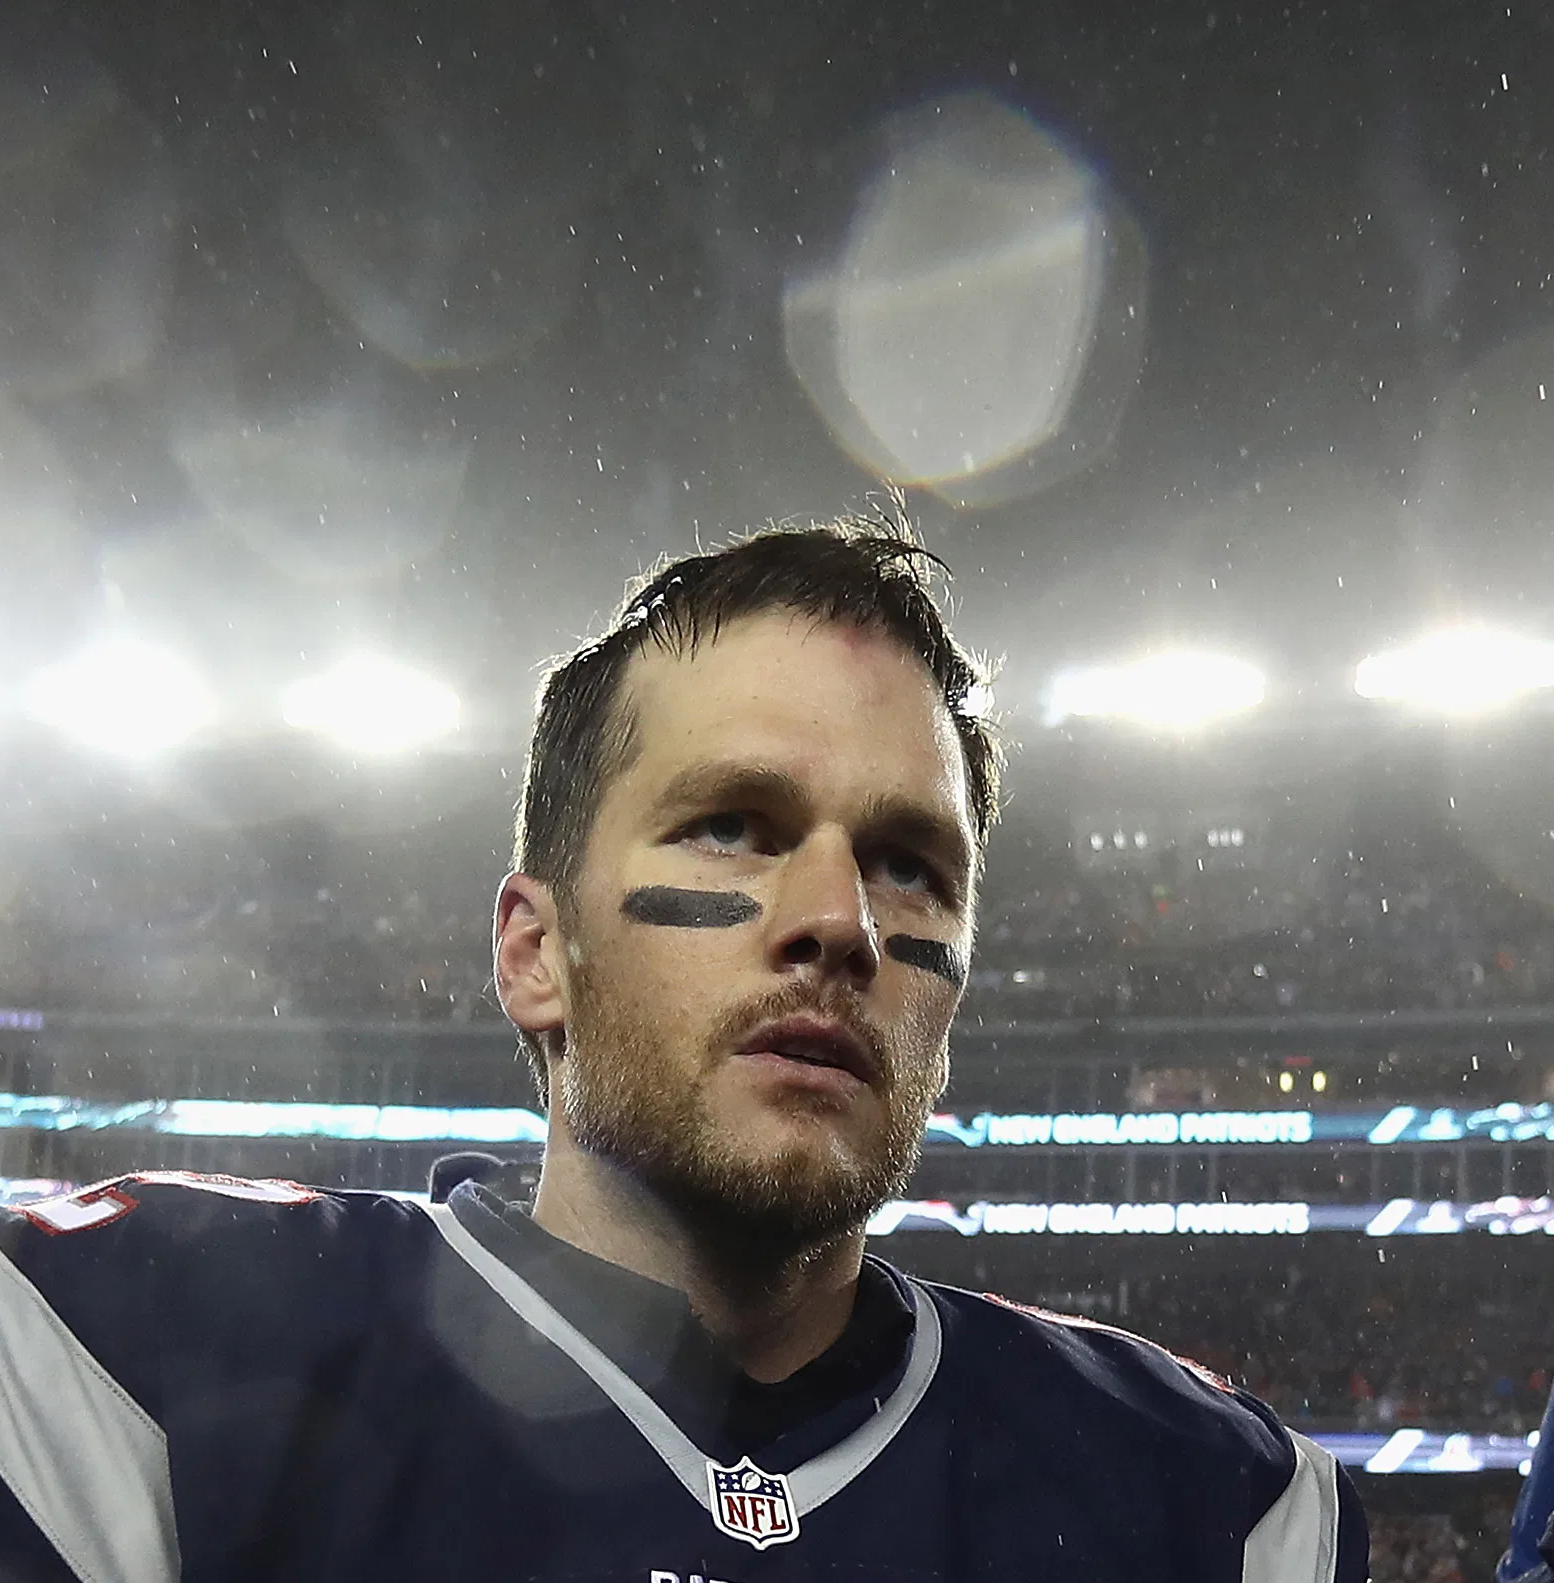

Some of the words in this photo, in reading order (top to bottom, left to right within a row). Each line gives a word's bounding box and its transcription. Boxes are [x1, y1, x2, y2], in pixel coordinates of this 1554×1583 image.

[988, 1114, 1051, 1144] NEW
[1052, 1113, 1179, 1144] ENGLAND
[1180, 1111, 1311, 1143] PATRIOTS
[983, 1203, 1047, 1234] NEW
[1176, 1202, 1309, 1234] PATRIOTS
[724, 1495, 786, 1534] NFL
